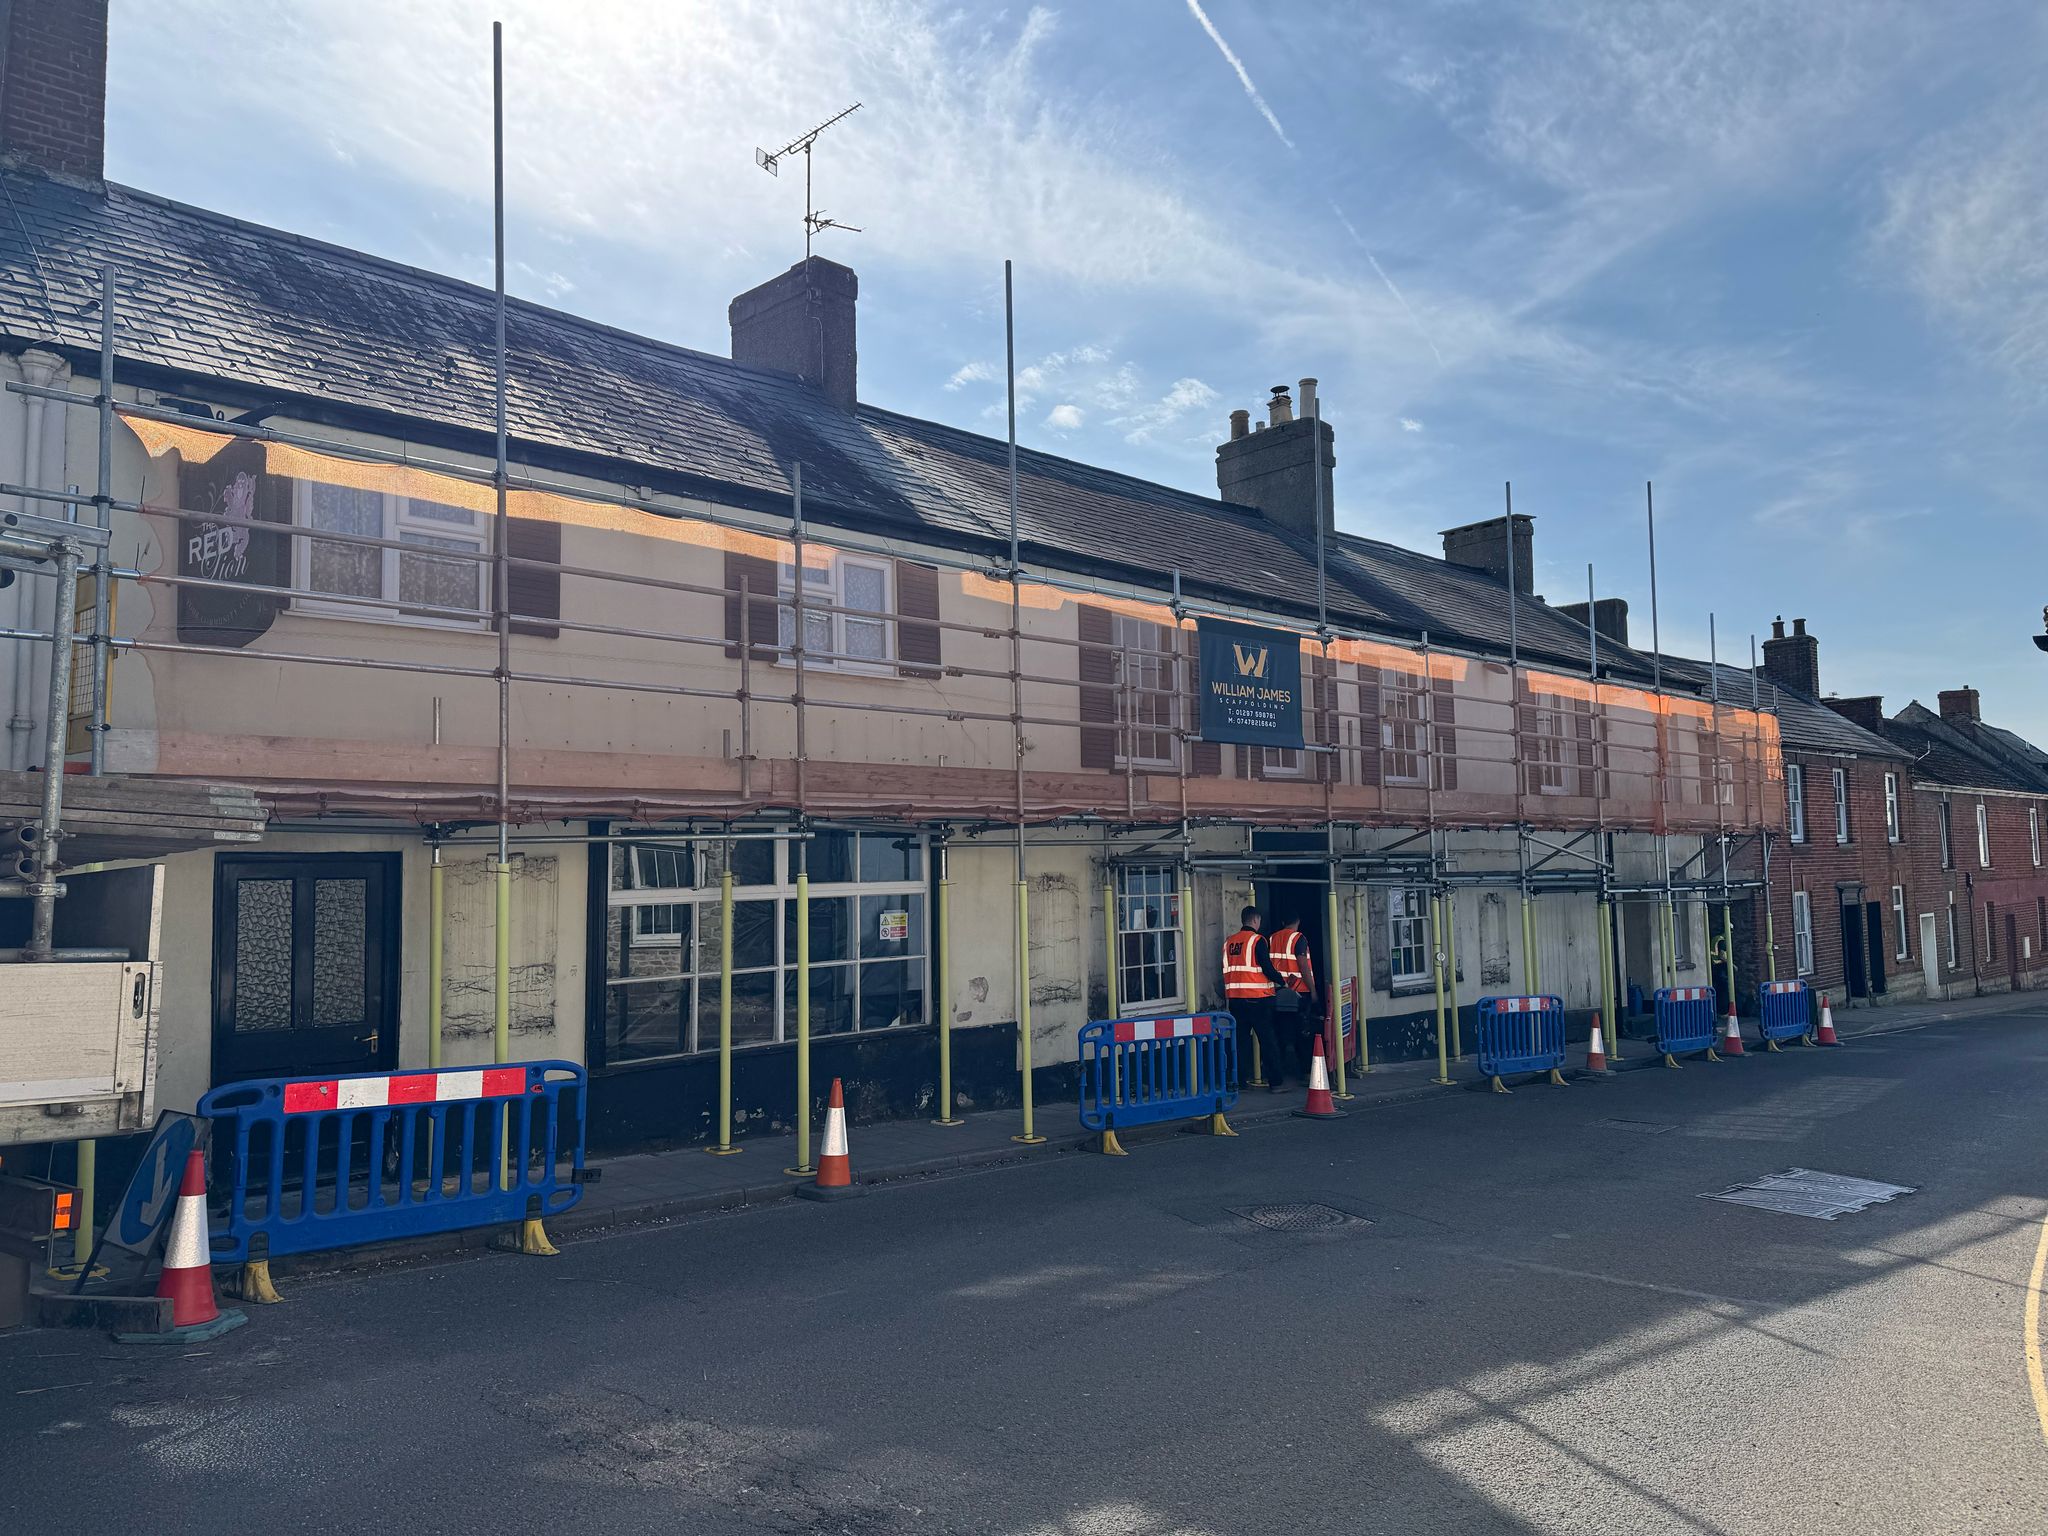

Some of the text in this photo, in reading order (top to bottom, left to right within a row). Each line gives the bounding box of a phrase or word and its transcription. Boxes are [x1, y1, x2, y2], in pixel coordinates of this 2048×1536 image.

[202, 522, 217, 532] THE
[189, 526, 234, 564] RED
[1212, 682, 1291, 703] WILLIAM JAMES
[1219, 698, 1284, 710] SCAFFOLDING
[1229, 942, 1244, 955] CAT
